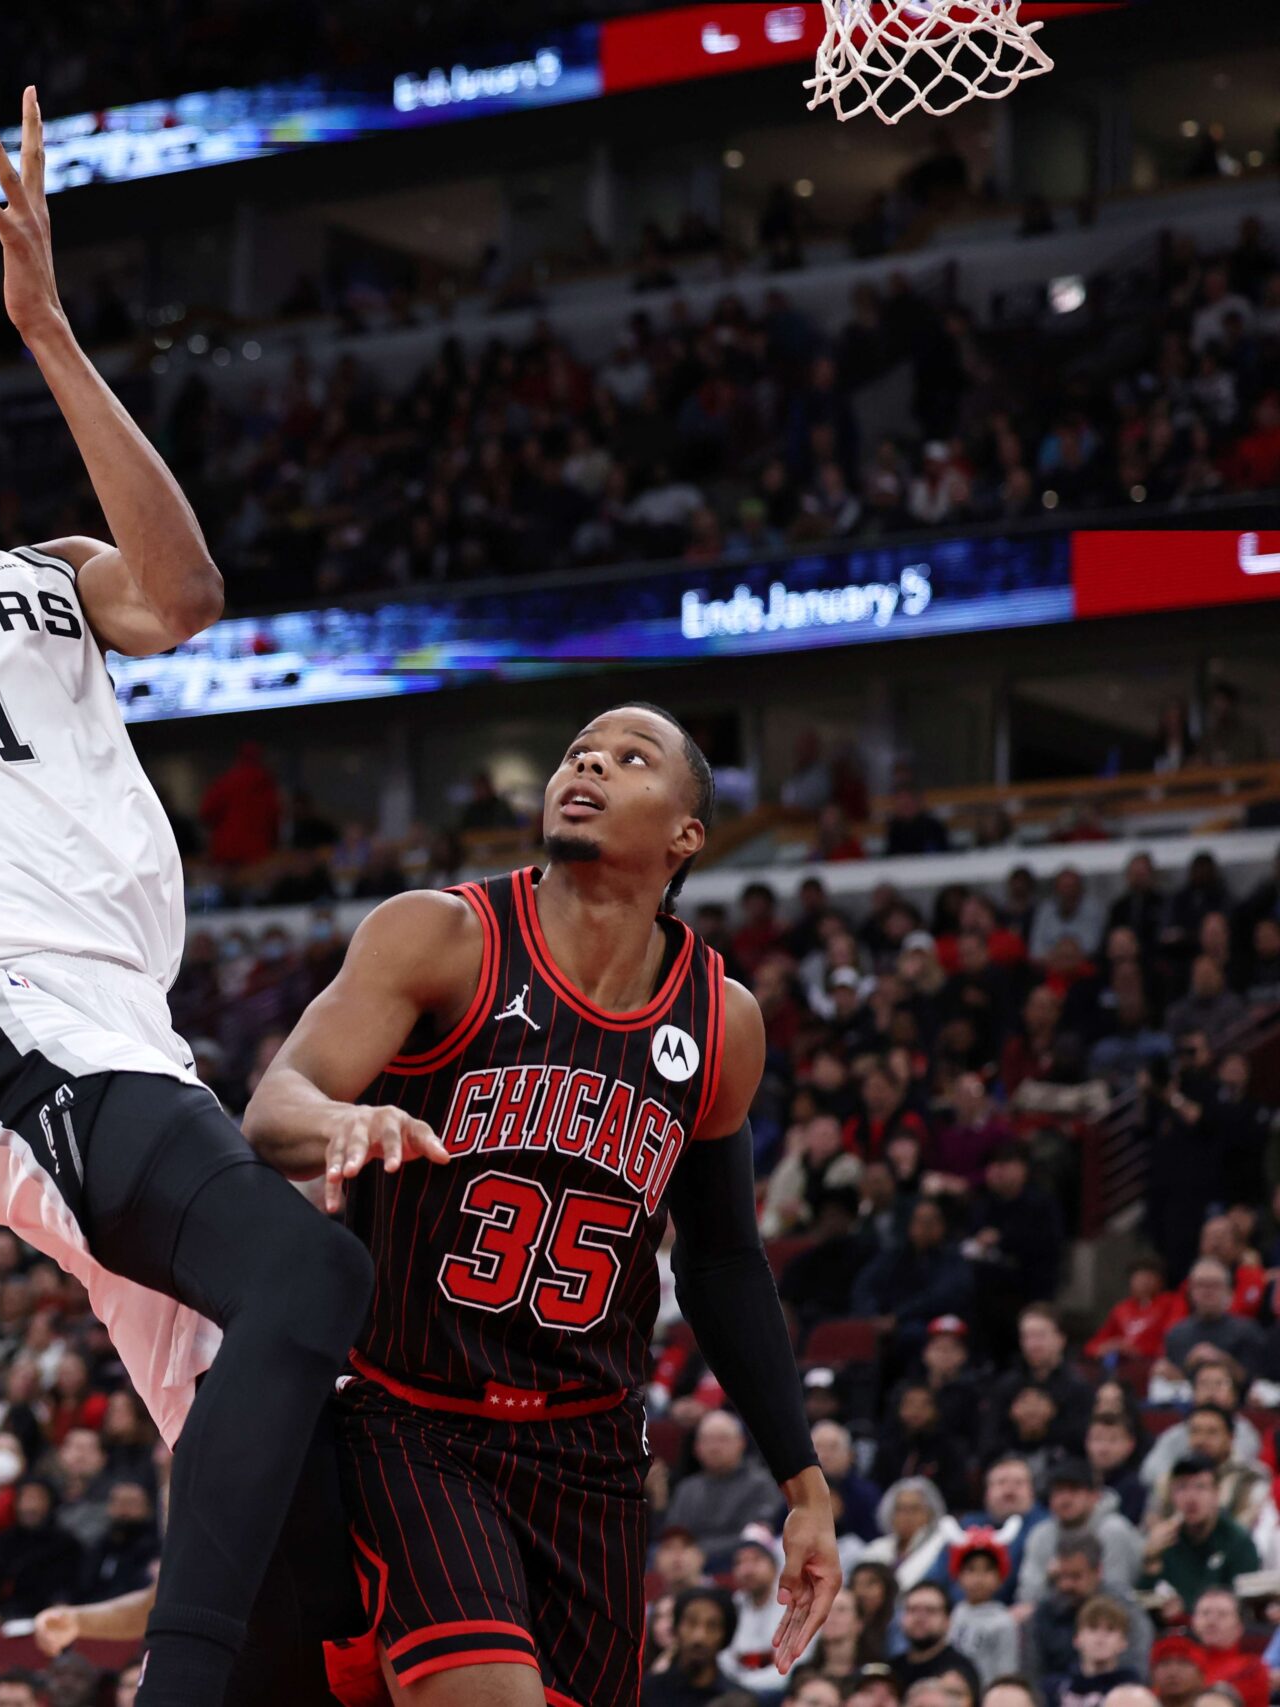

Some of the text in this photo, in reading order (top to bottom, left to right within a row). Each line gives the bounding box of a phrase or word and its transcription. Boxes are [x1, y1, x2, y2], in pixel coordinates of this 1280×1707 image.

[682, 584, 764, 638] Ends
[764, 581, 898, 629] January
[442, 1065, 685, 1218] CHICAGO
[437, 1170, 641, 1332] 35
